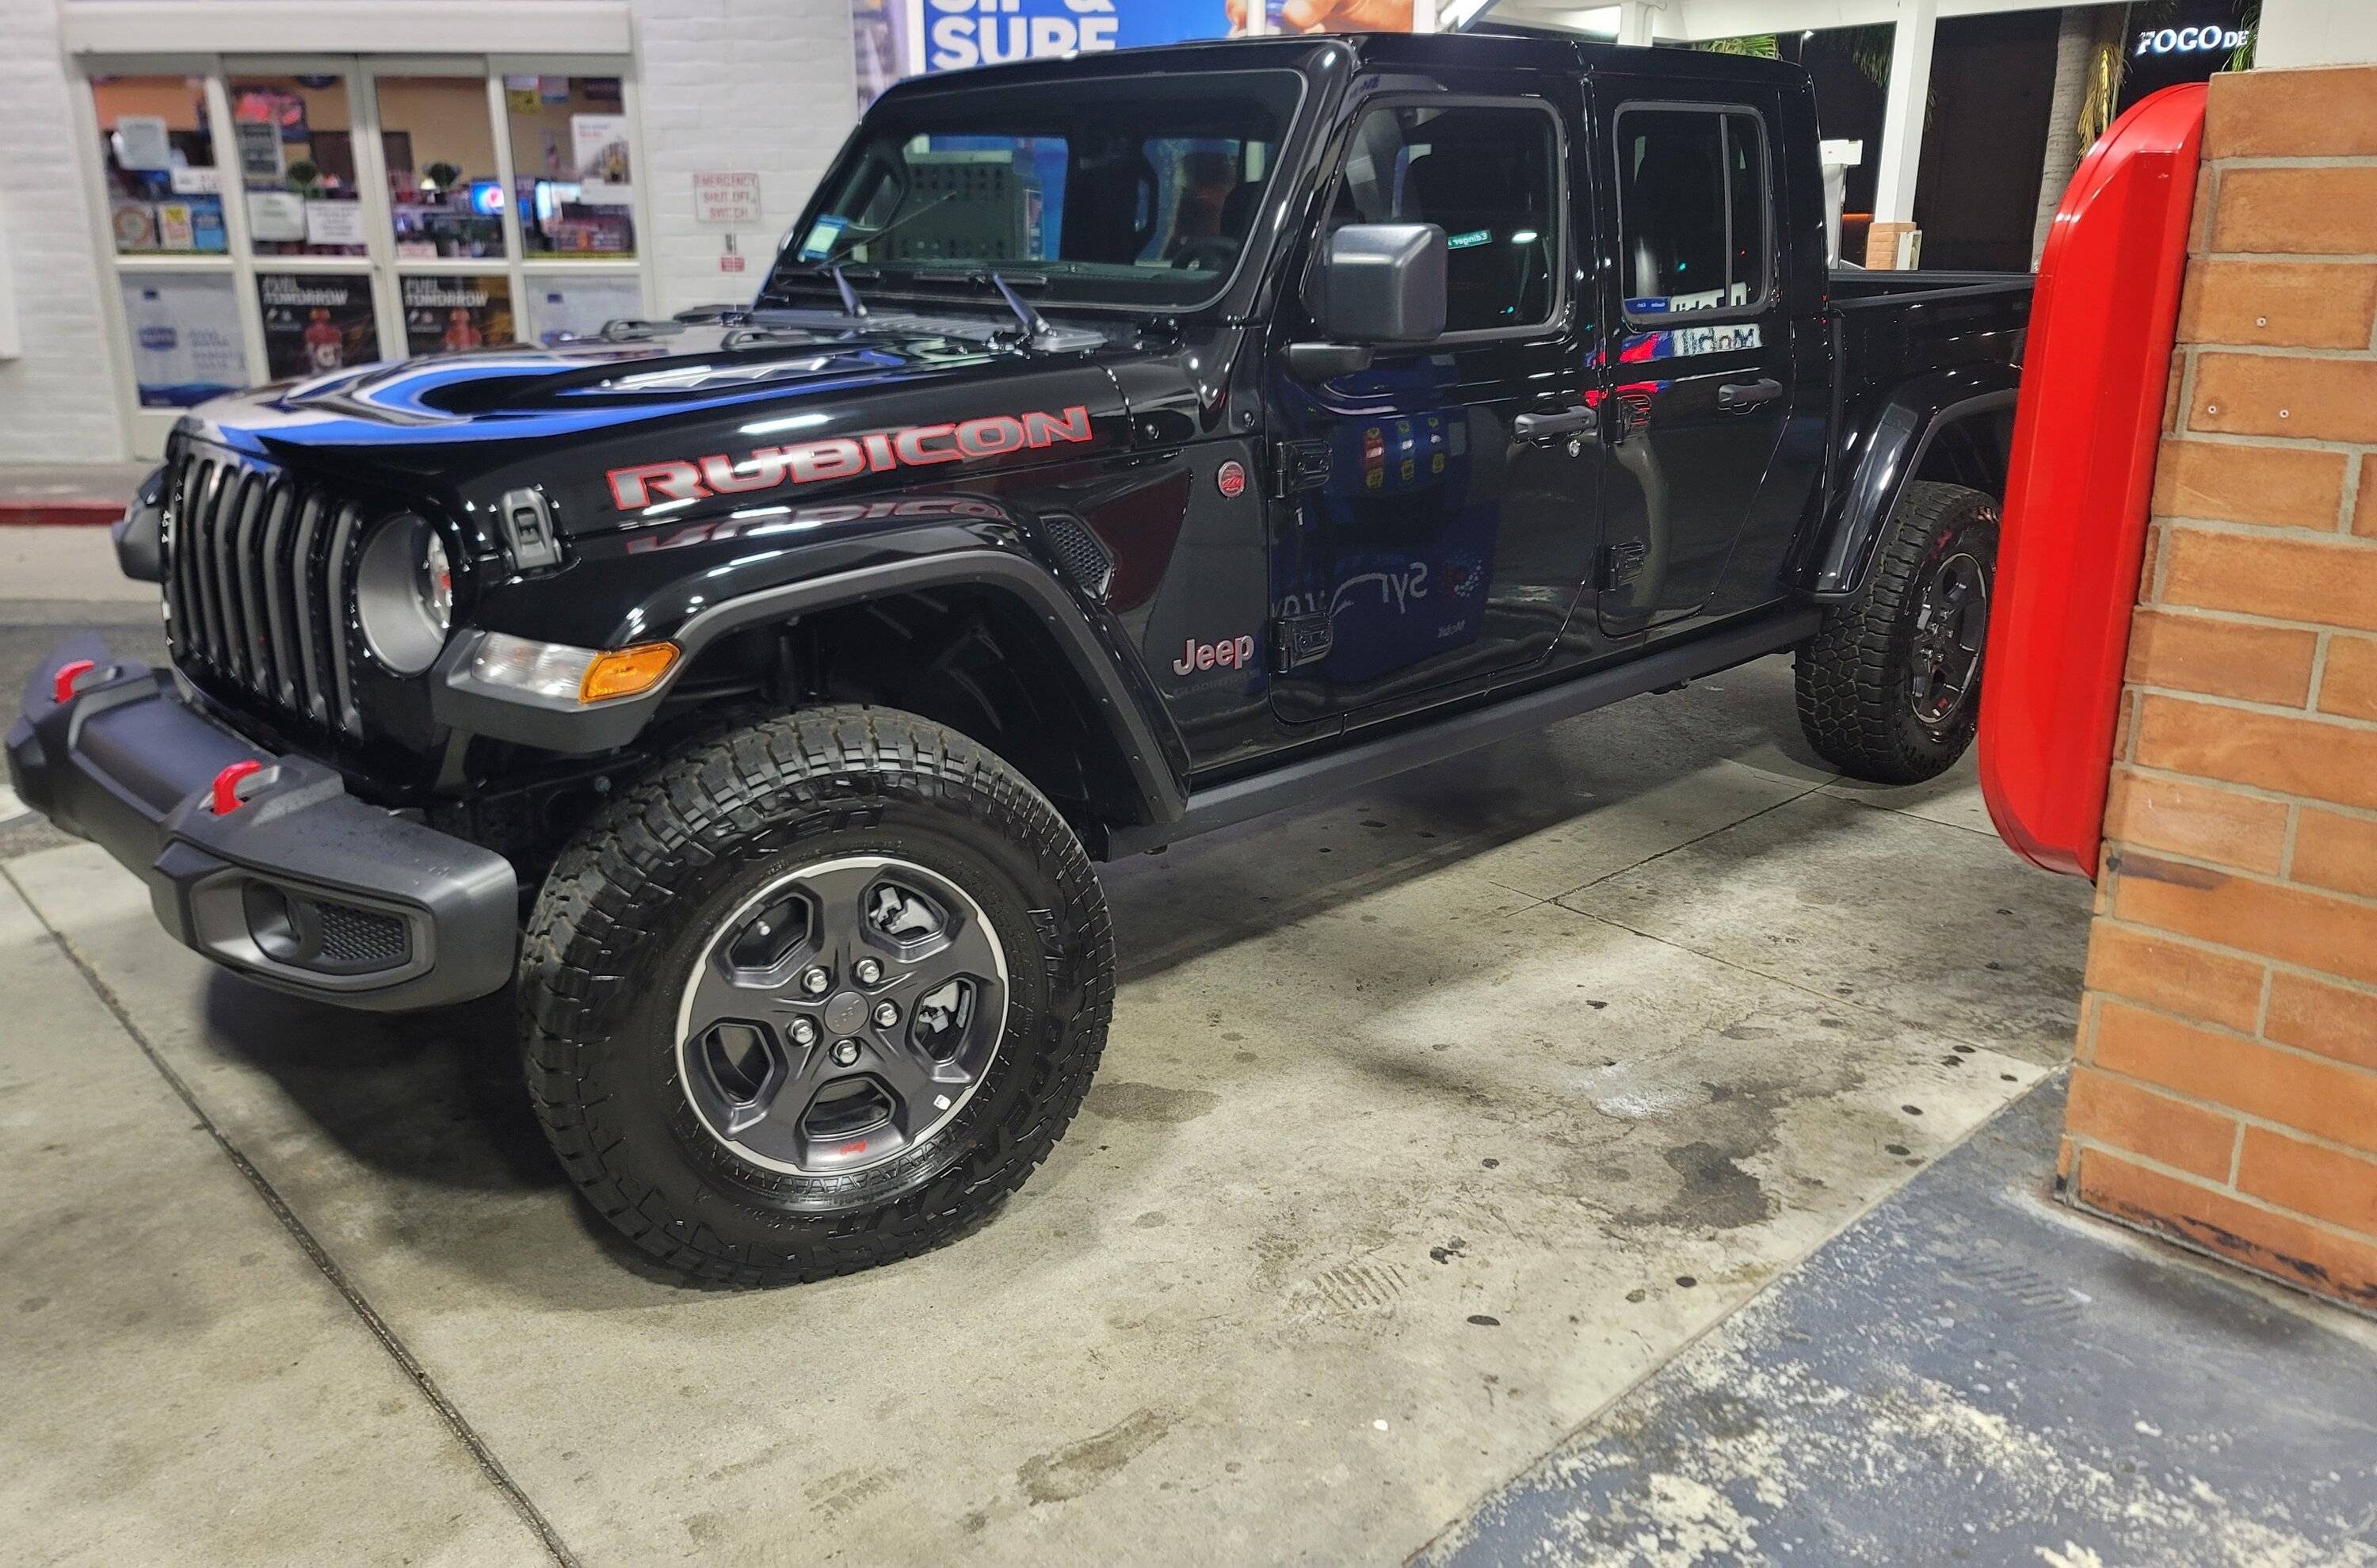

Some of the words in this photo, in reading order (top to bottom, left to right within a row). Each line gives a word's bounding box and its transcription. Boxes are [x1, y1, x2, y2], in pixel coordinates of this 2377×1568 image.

[2135, 25, 2222, 55] FOGO
[2222, 30, 2249, 49] DE
[607, 405, 1094, 511] RUBICON
[1173, 635, 1254, 677] Jeep
